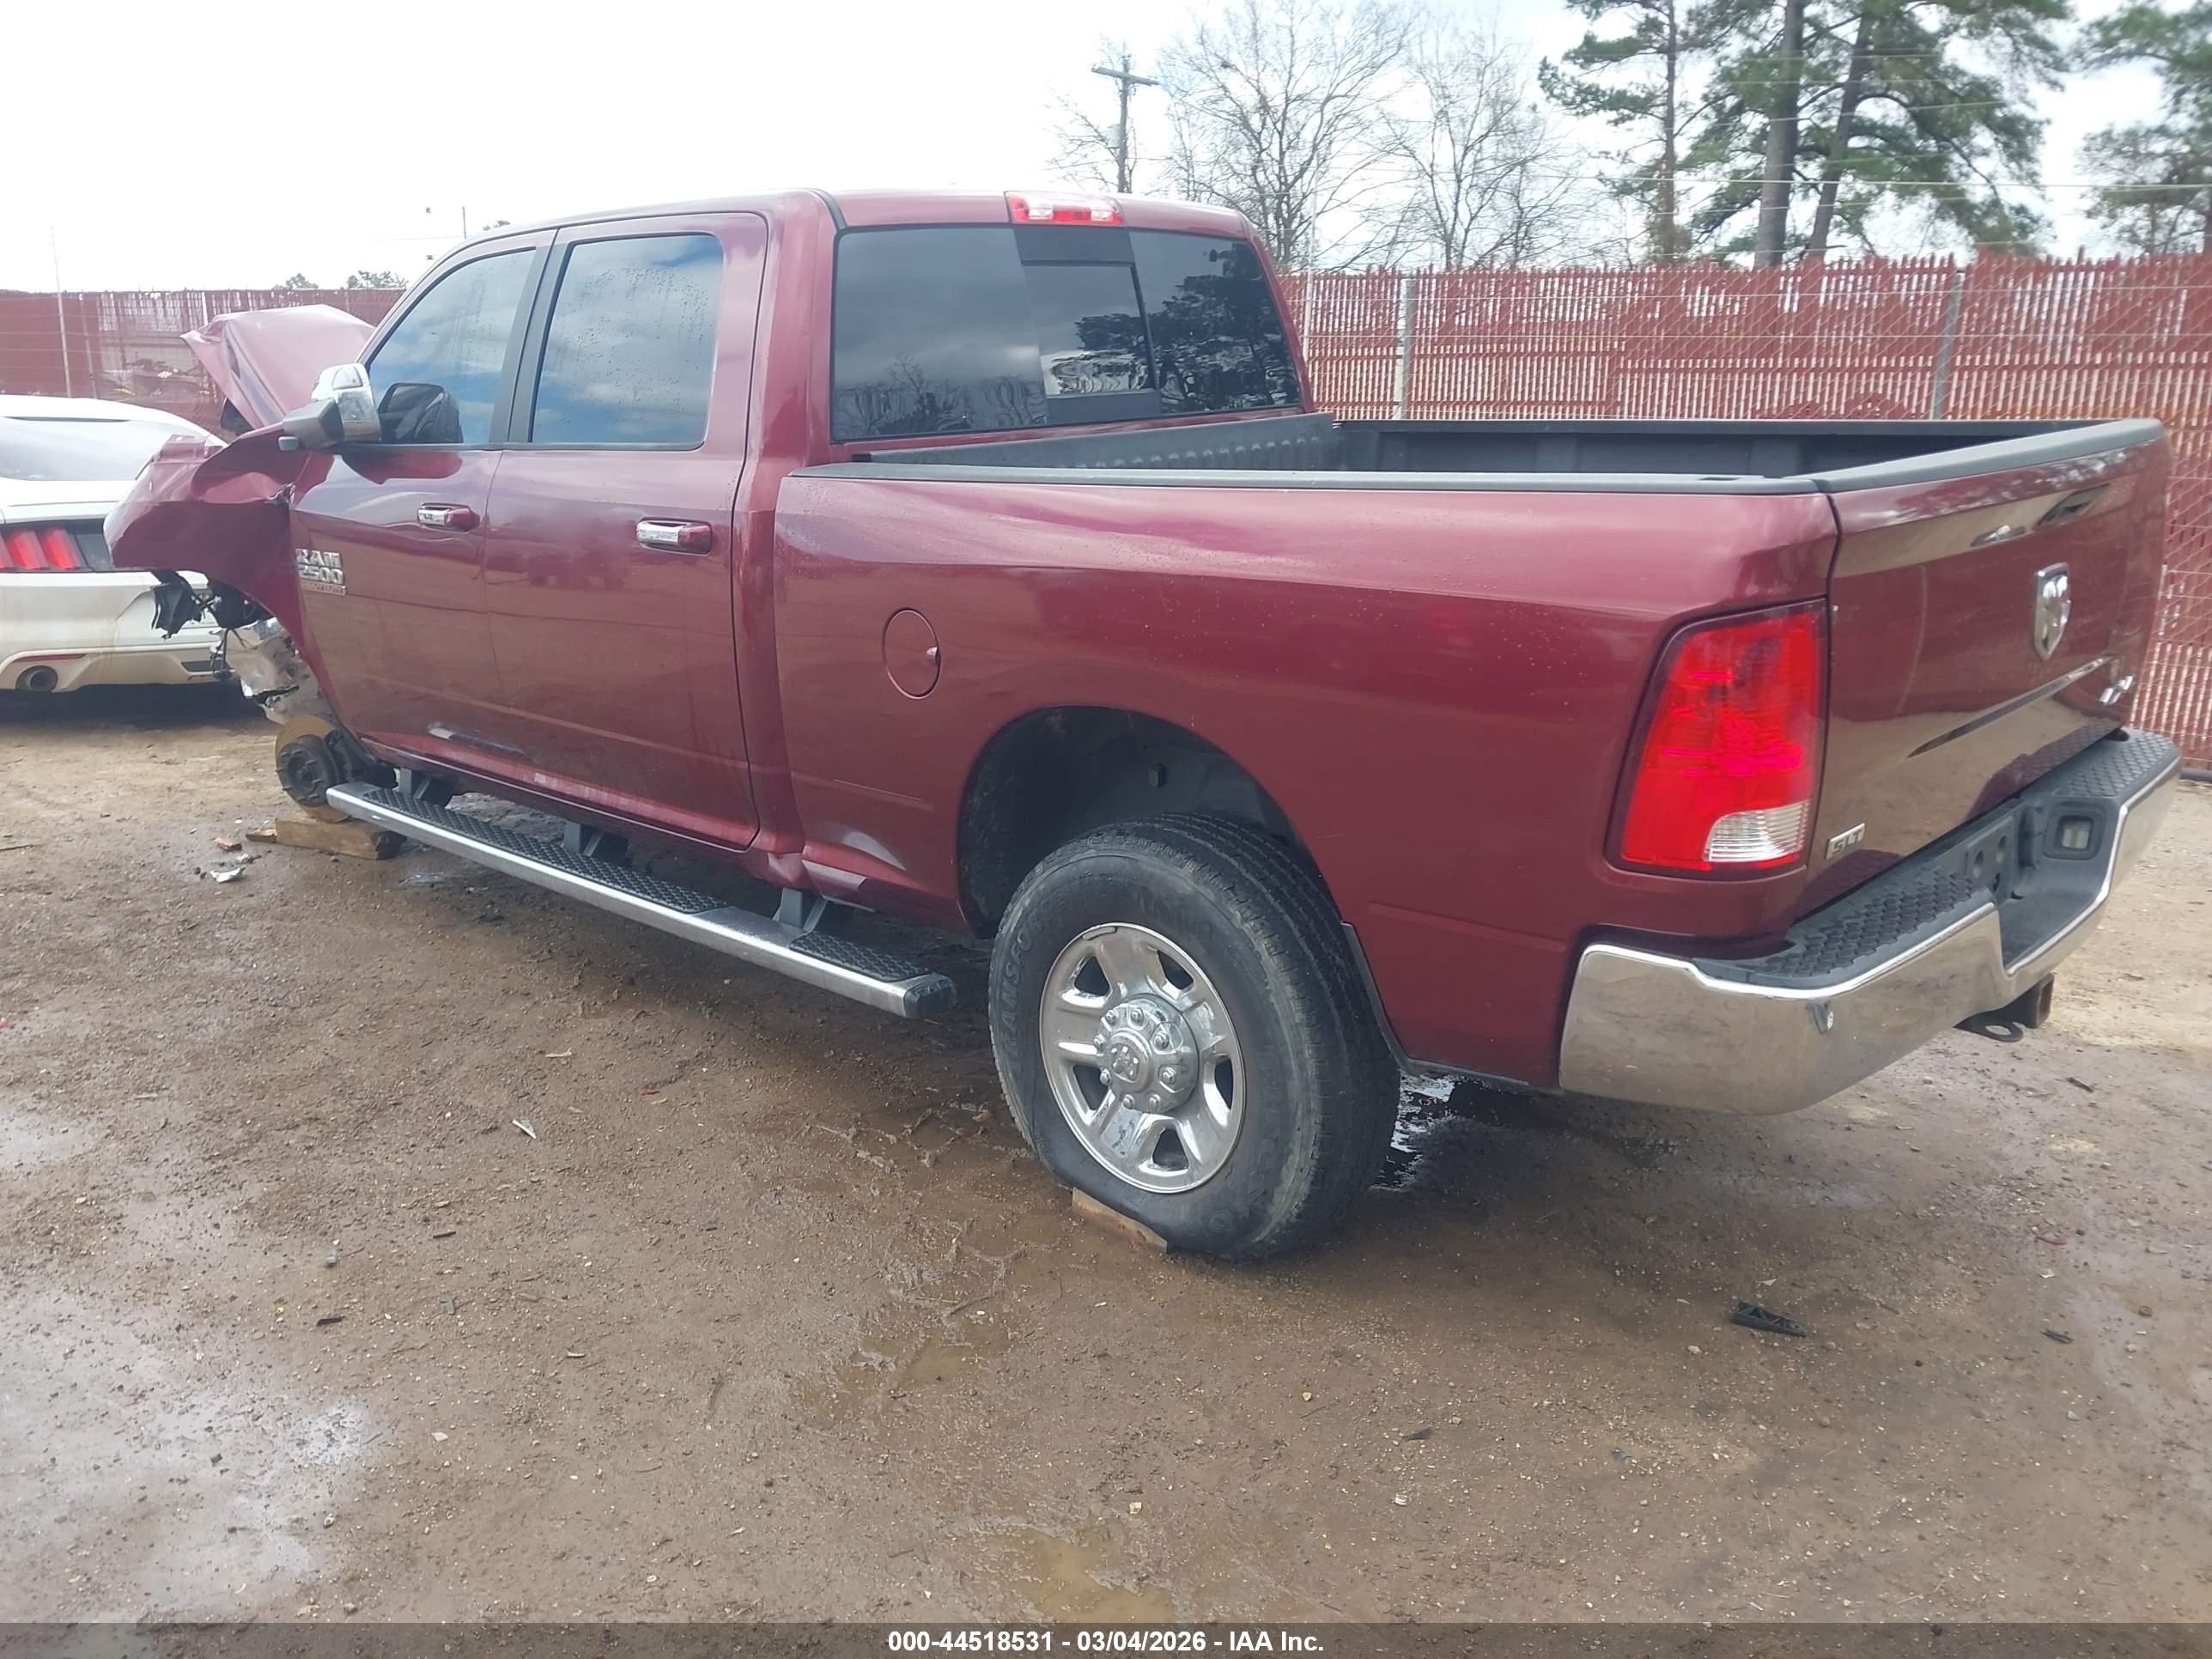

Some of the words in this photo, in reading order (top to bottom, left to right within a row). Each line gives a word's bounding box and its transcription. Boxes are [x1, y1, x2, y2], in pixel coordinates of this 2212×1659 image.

[295, 549, 341, 568] RAM
[298, 564, 345, 584] 2500
[1830, 825, 1864, 857] SLT
